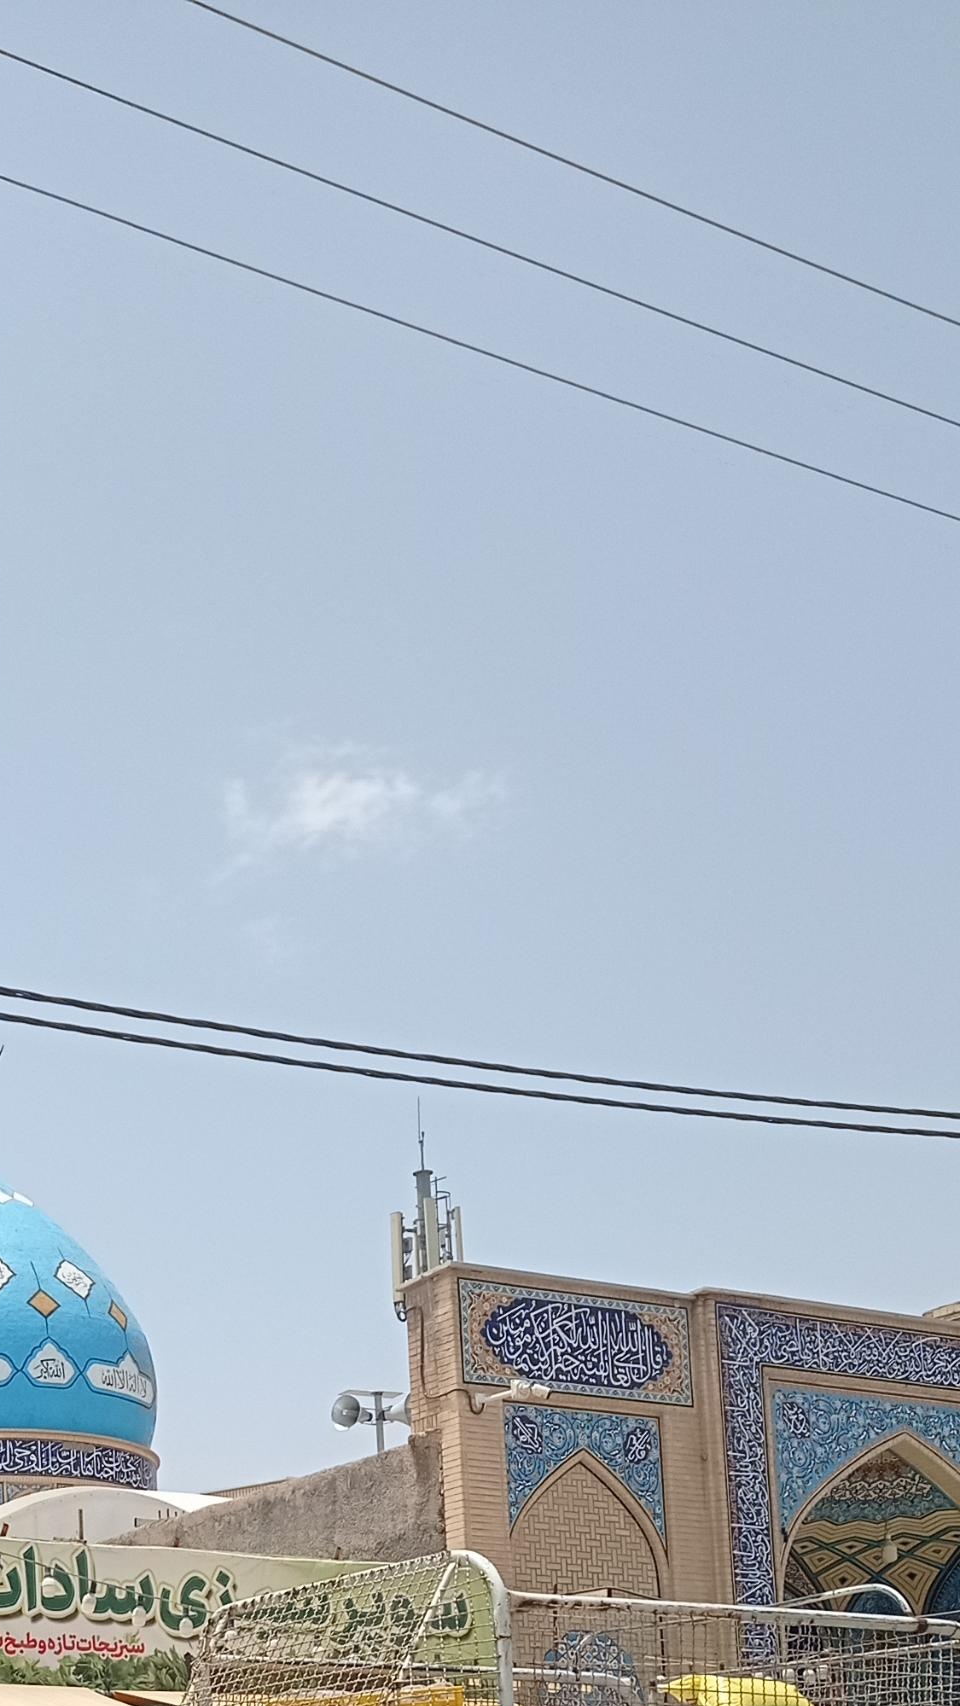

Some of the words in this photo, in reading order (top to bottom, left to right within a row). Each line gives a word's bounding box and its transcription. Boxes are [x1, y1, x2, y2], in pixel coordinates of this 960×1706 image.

[4, 1631, 38, 1655] طبخ
[37, 1642, 47, 1654] و
[47, 1633, 77, 1655] تازه
[76, 1635, 146, 1658] سبزیجات
